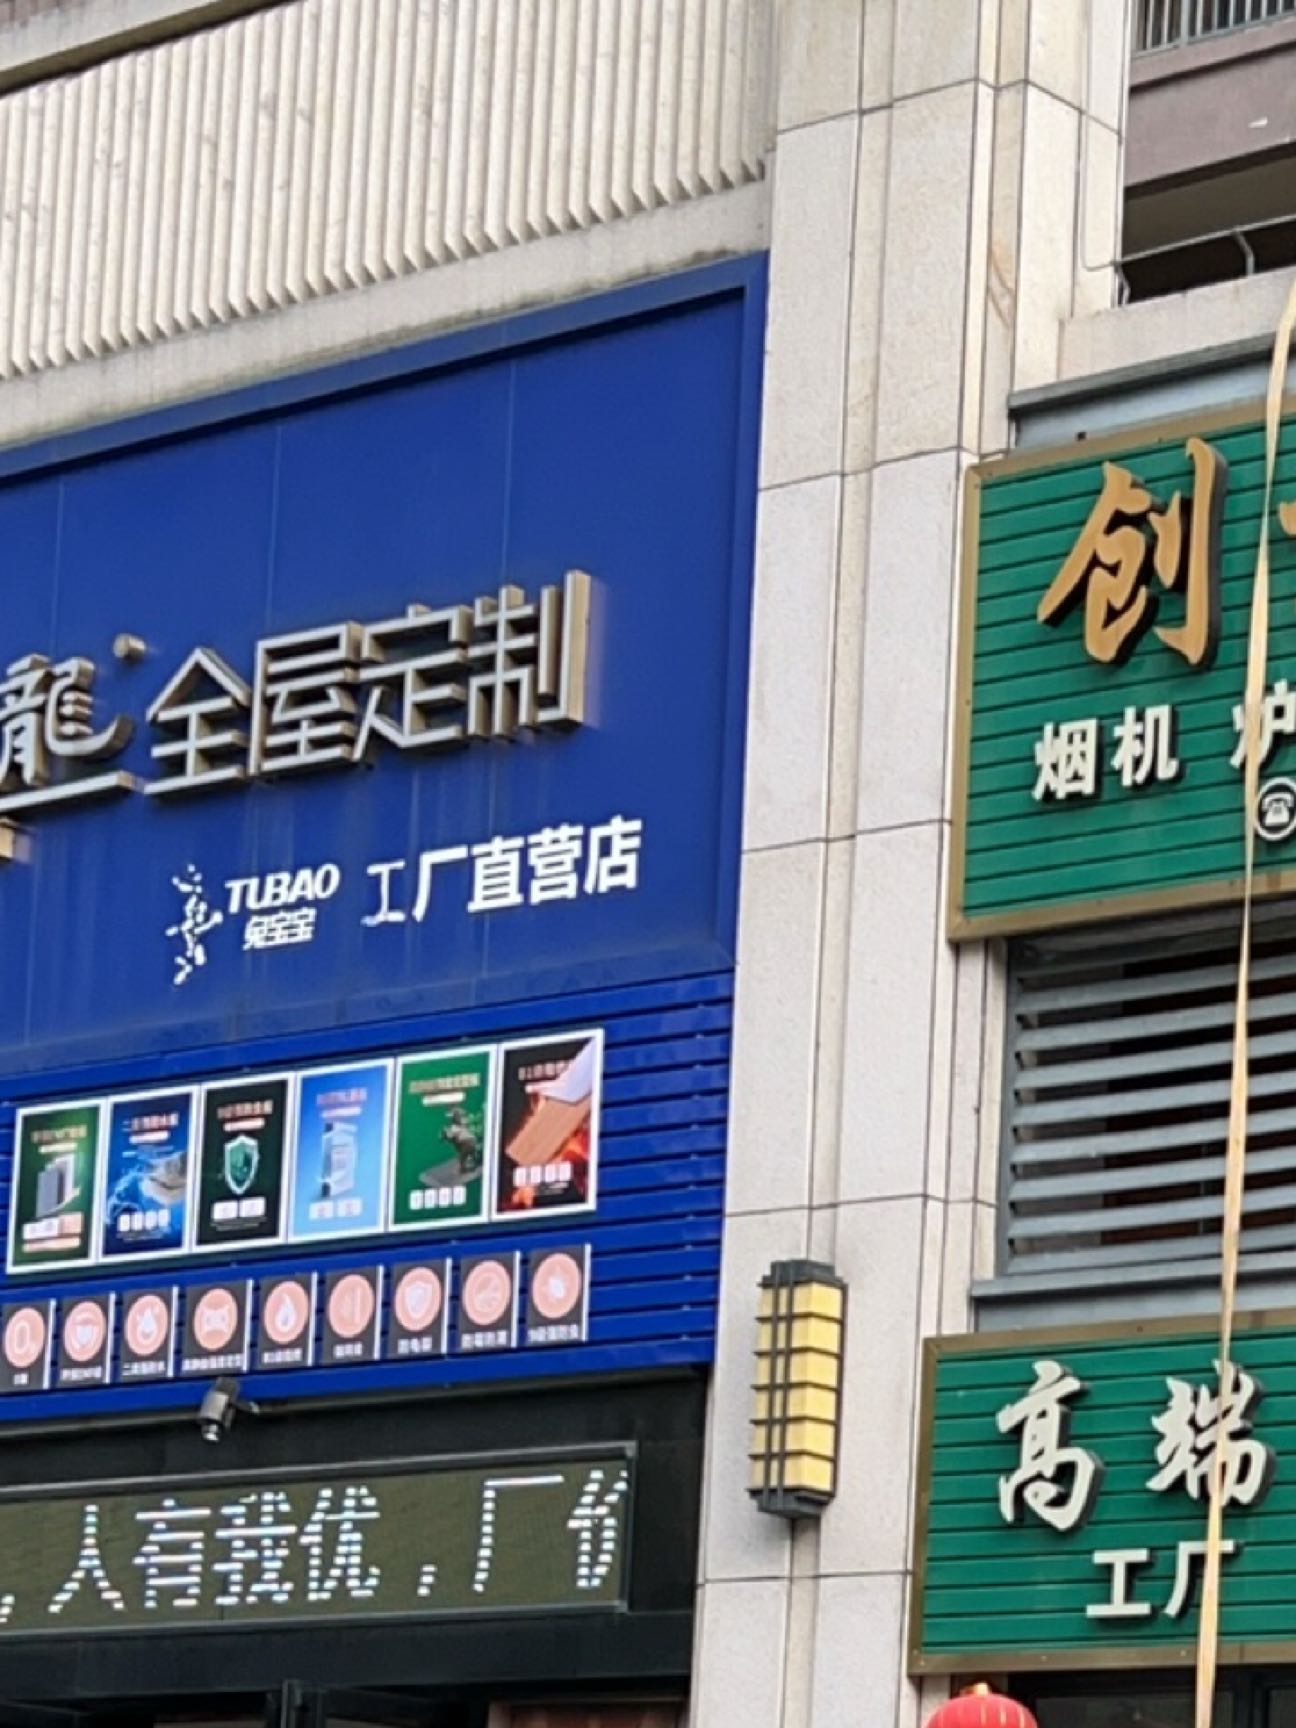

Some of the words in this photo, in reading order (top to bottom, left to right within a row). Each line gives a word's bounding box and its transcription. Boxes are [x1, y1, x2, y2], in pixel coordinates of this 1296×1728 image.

[143, 569, 592, 797] 全屋定制
[1032, 705, 1179, 801] 烟机
[224, 863, 340, 914] TUBAO
[361, 815, 643, 926] 工厂直营店
[243, 907, 317, 951] 兔宝宝
[1086, 1540, 1236, 1619] 工厂
